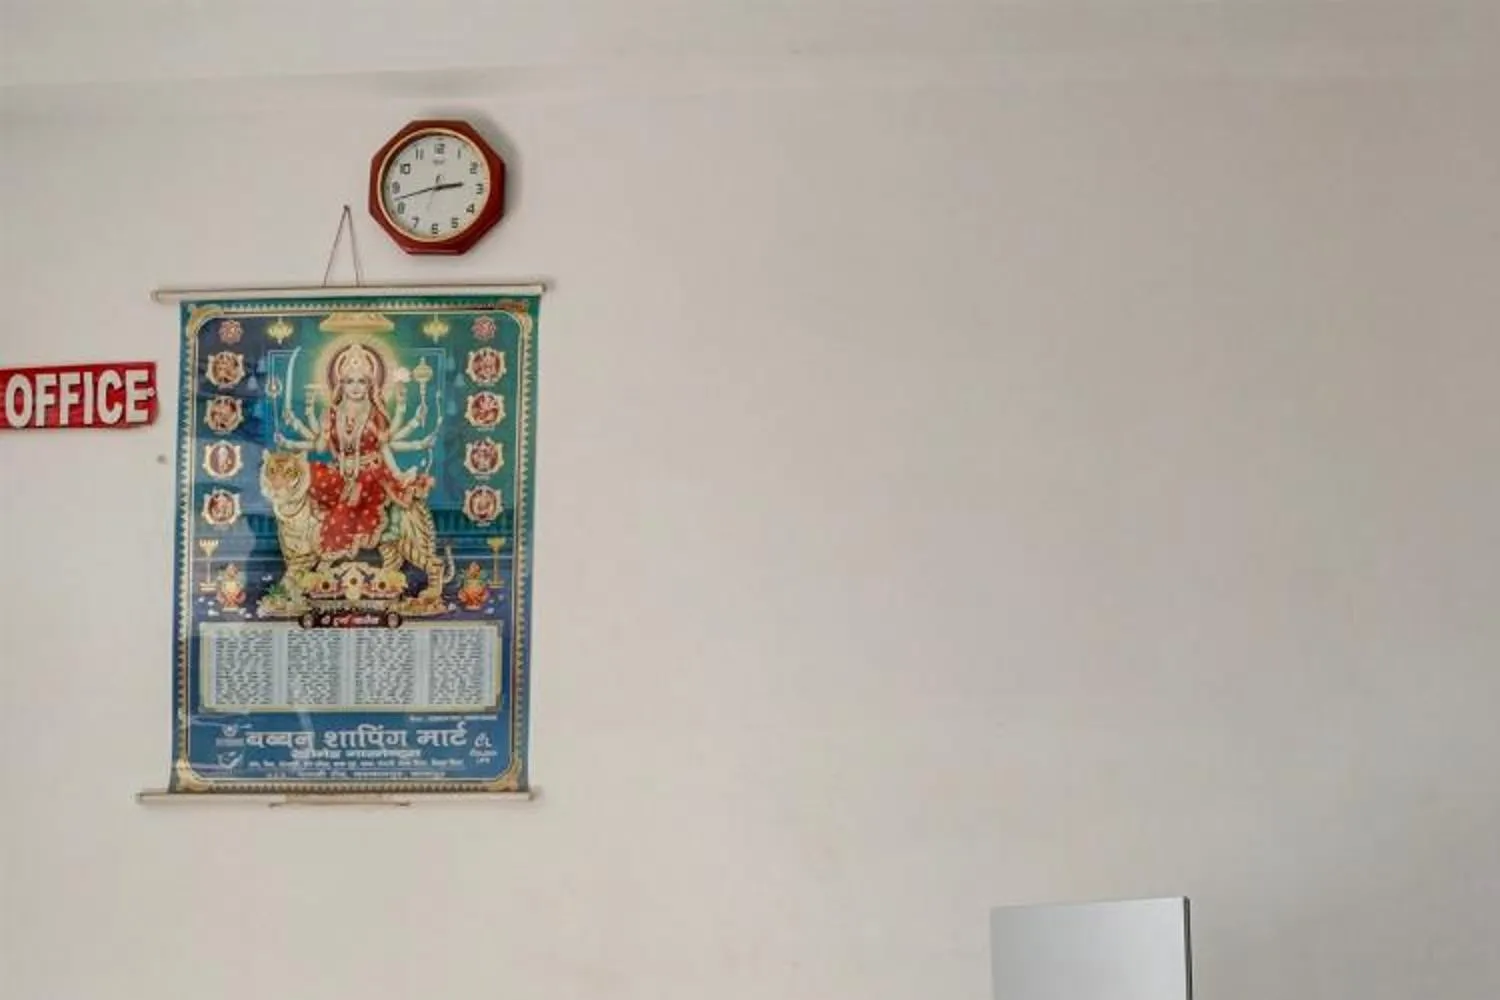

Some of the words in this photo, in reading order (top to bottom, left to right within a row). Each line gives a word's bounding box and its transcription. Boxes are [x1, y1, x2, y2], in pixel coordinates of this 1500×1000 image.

[475, 183, 484, 194] 3
[466, 203, 475, 214] 4
[412, 216, 419, 228] 7
[4, 368, 149, 429] OFFICE
